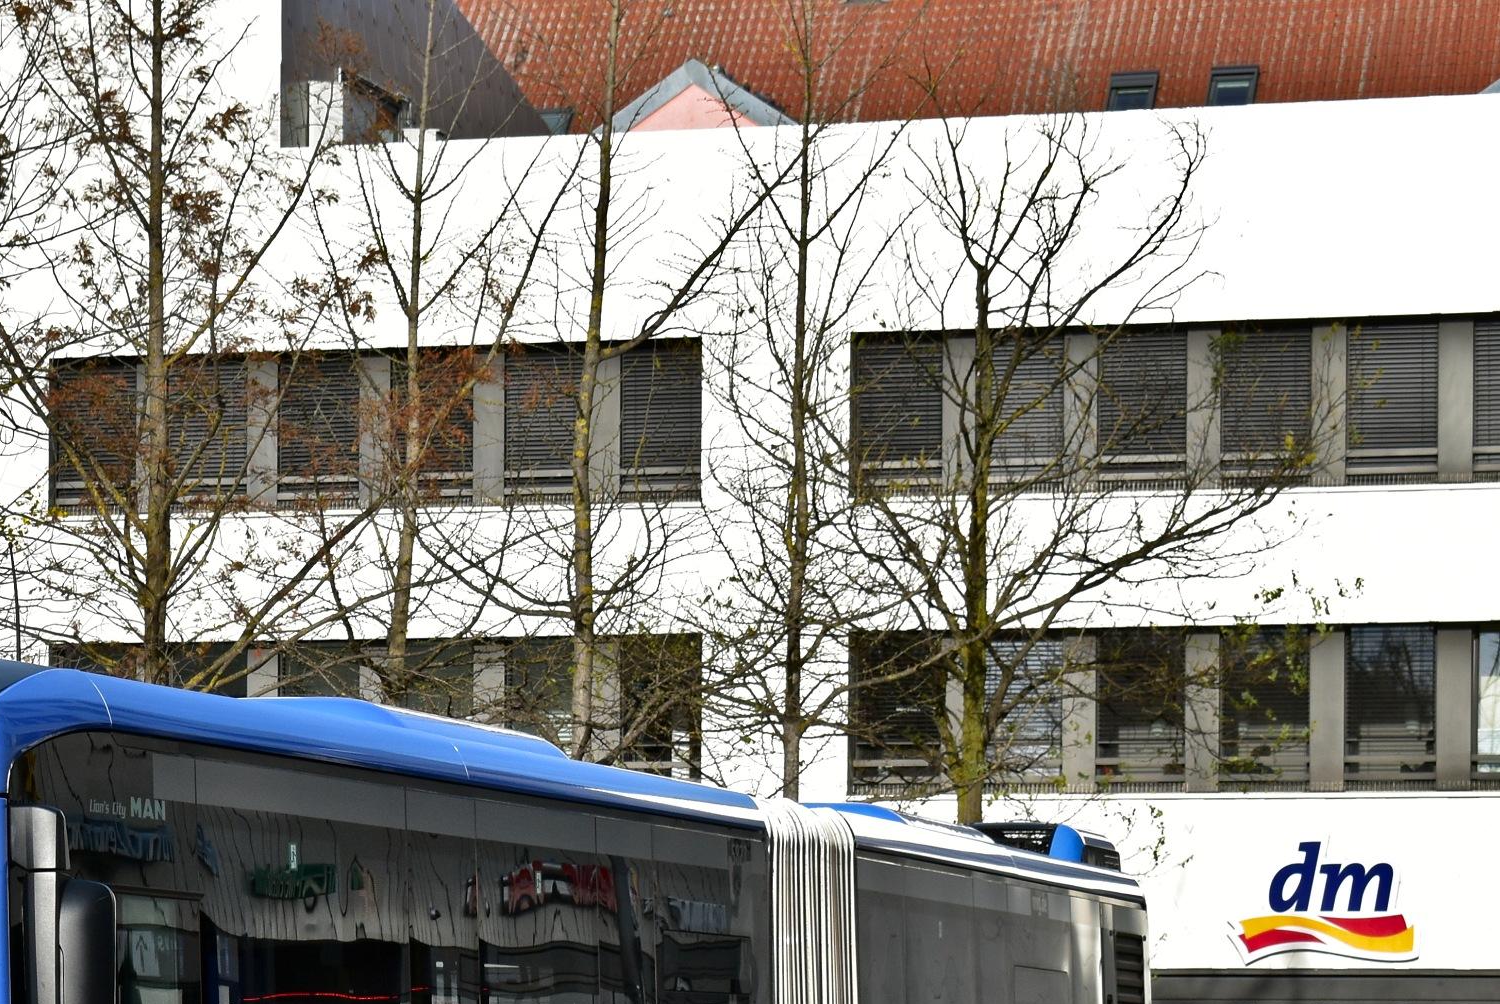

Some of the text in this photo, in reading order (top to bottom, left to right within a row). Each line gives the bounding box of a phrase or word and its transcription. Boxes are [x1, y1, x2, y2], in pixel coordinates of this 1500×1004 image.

[89, 796, 166, 821] Lion's City MAN
[1268, 841, 1394, 913] dm
